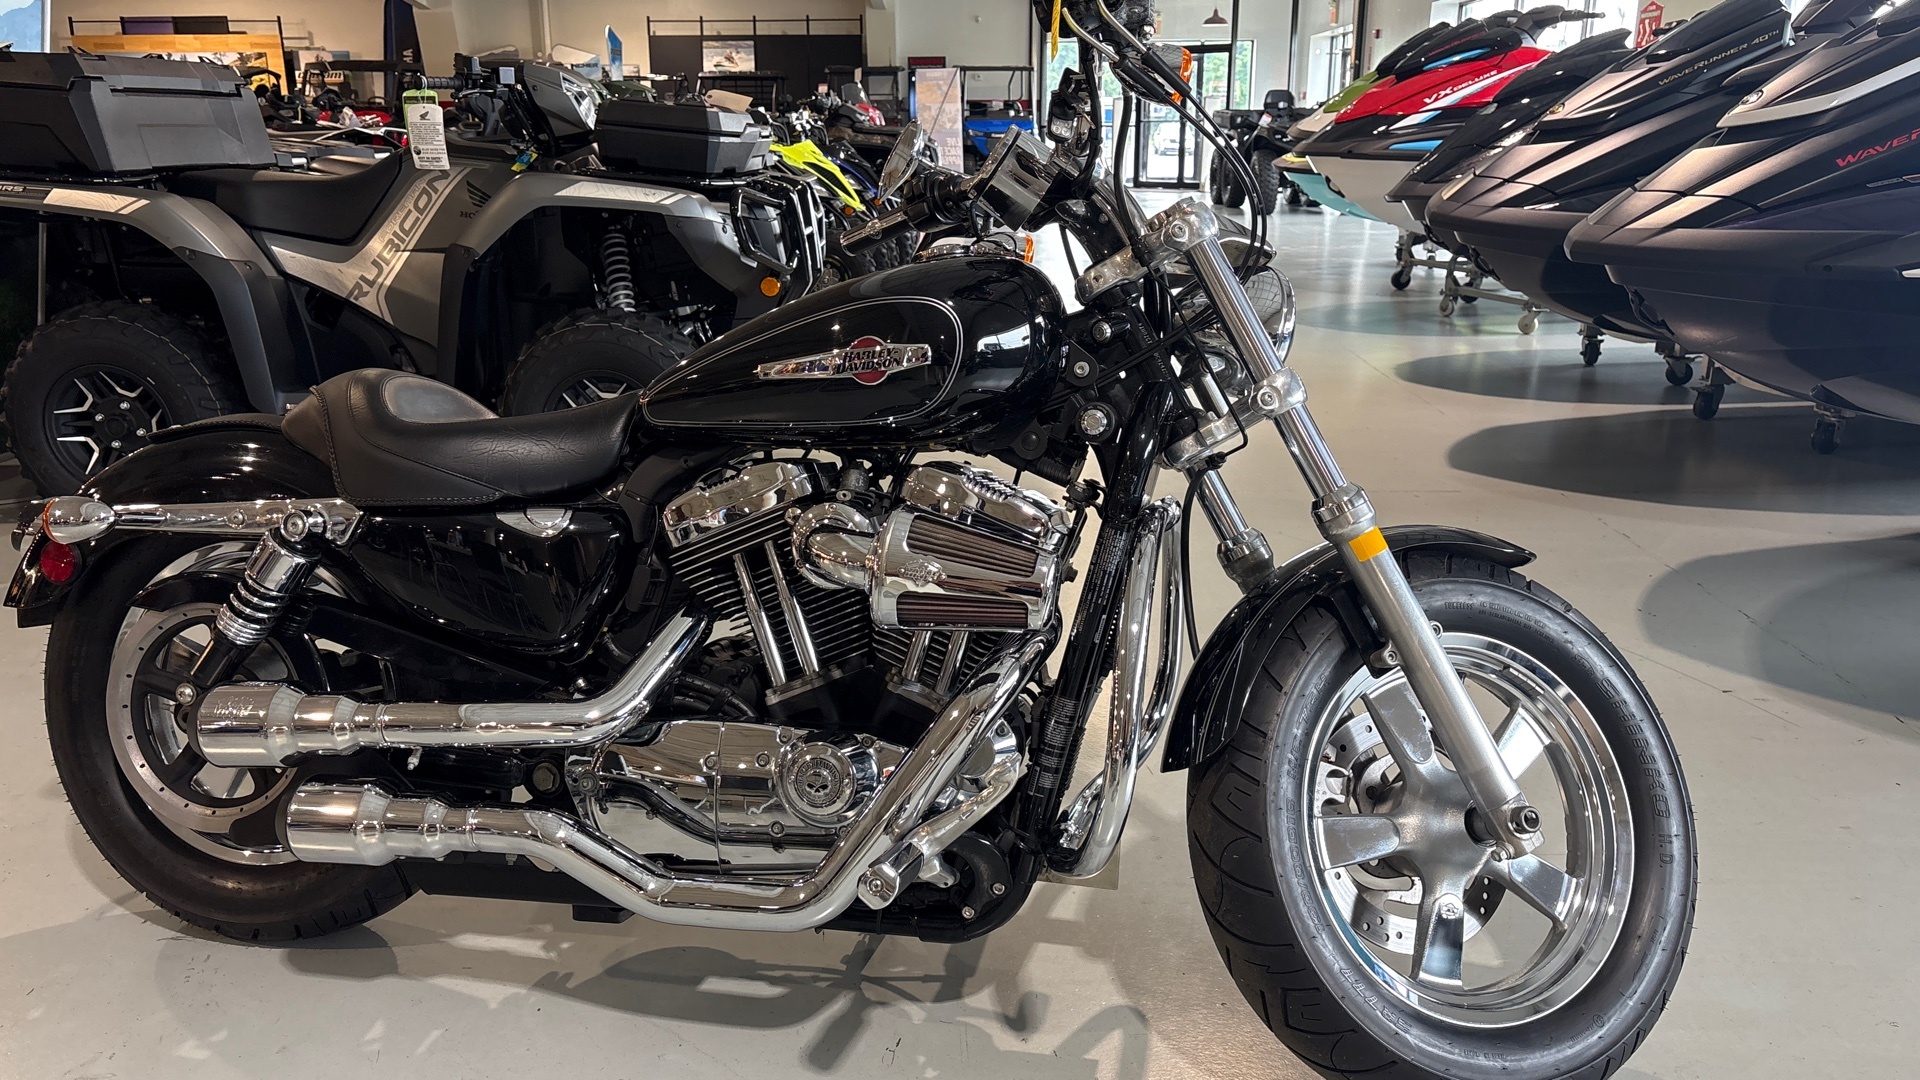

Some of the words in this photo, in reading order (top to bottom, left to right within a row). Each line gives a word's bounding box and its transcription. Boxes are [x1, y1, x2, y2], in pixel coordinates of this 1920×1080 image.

[1658, 42, 1749, 86] WAVERUNNER
[1423, 86, 1453, 104] VX
[1453, 69, 1498, 92] DELUXE
[345, 169, 451, 302] RUBICON
[835, 357, 902, 374] DAVIDSON
[843, 347, 899, 362] HARLEY-
[1595, 677, 1671, 819] SHINKO
